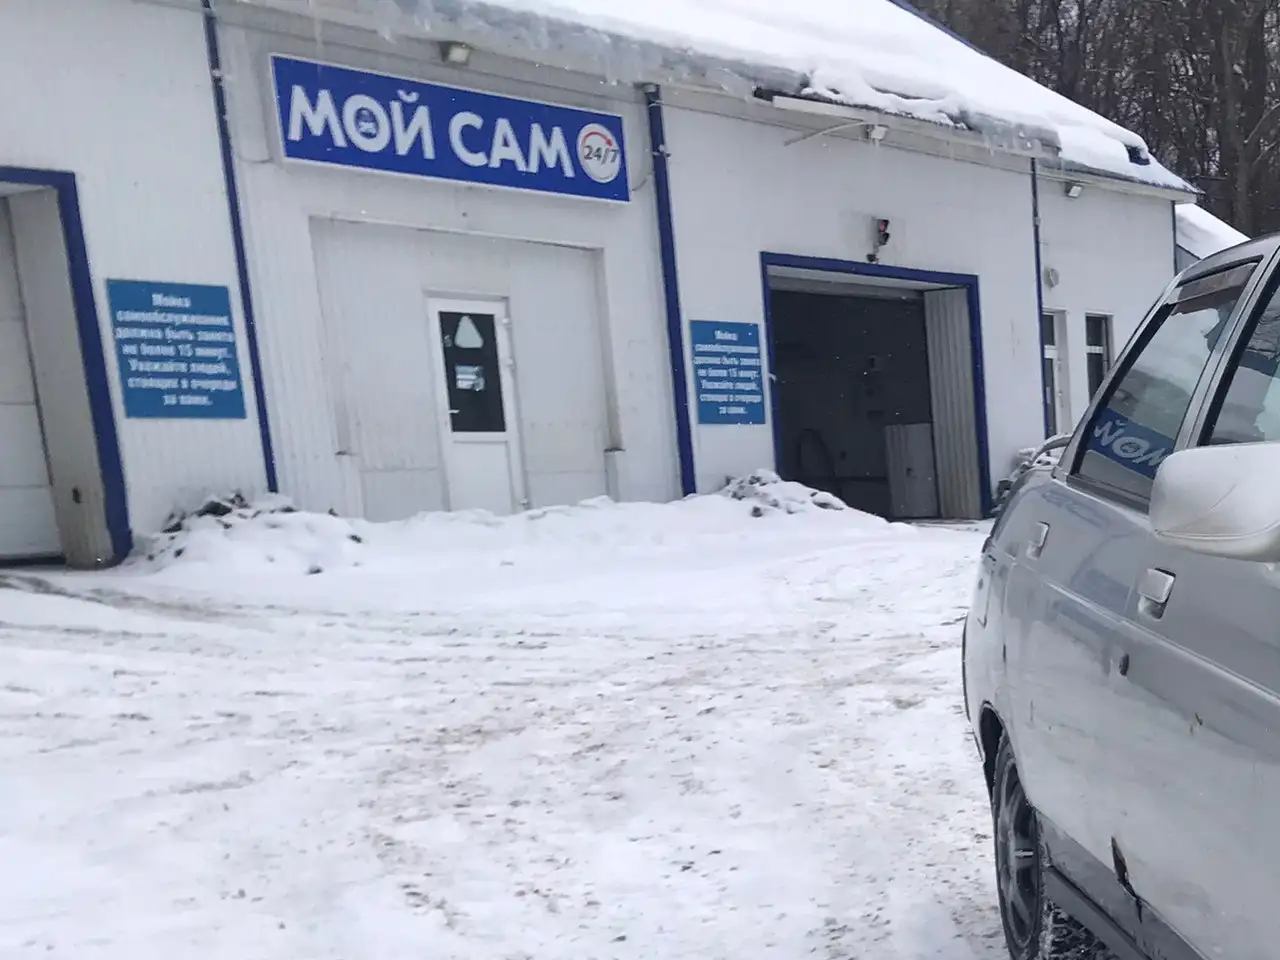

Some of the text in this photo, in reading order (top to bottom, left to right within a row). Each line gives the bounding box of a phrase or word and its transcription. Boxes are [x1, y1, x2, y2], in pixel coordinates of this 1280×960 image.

[287, 84, 576, 178] МОЙ САМ
[583, 145, 619, 164] 24/7
